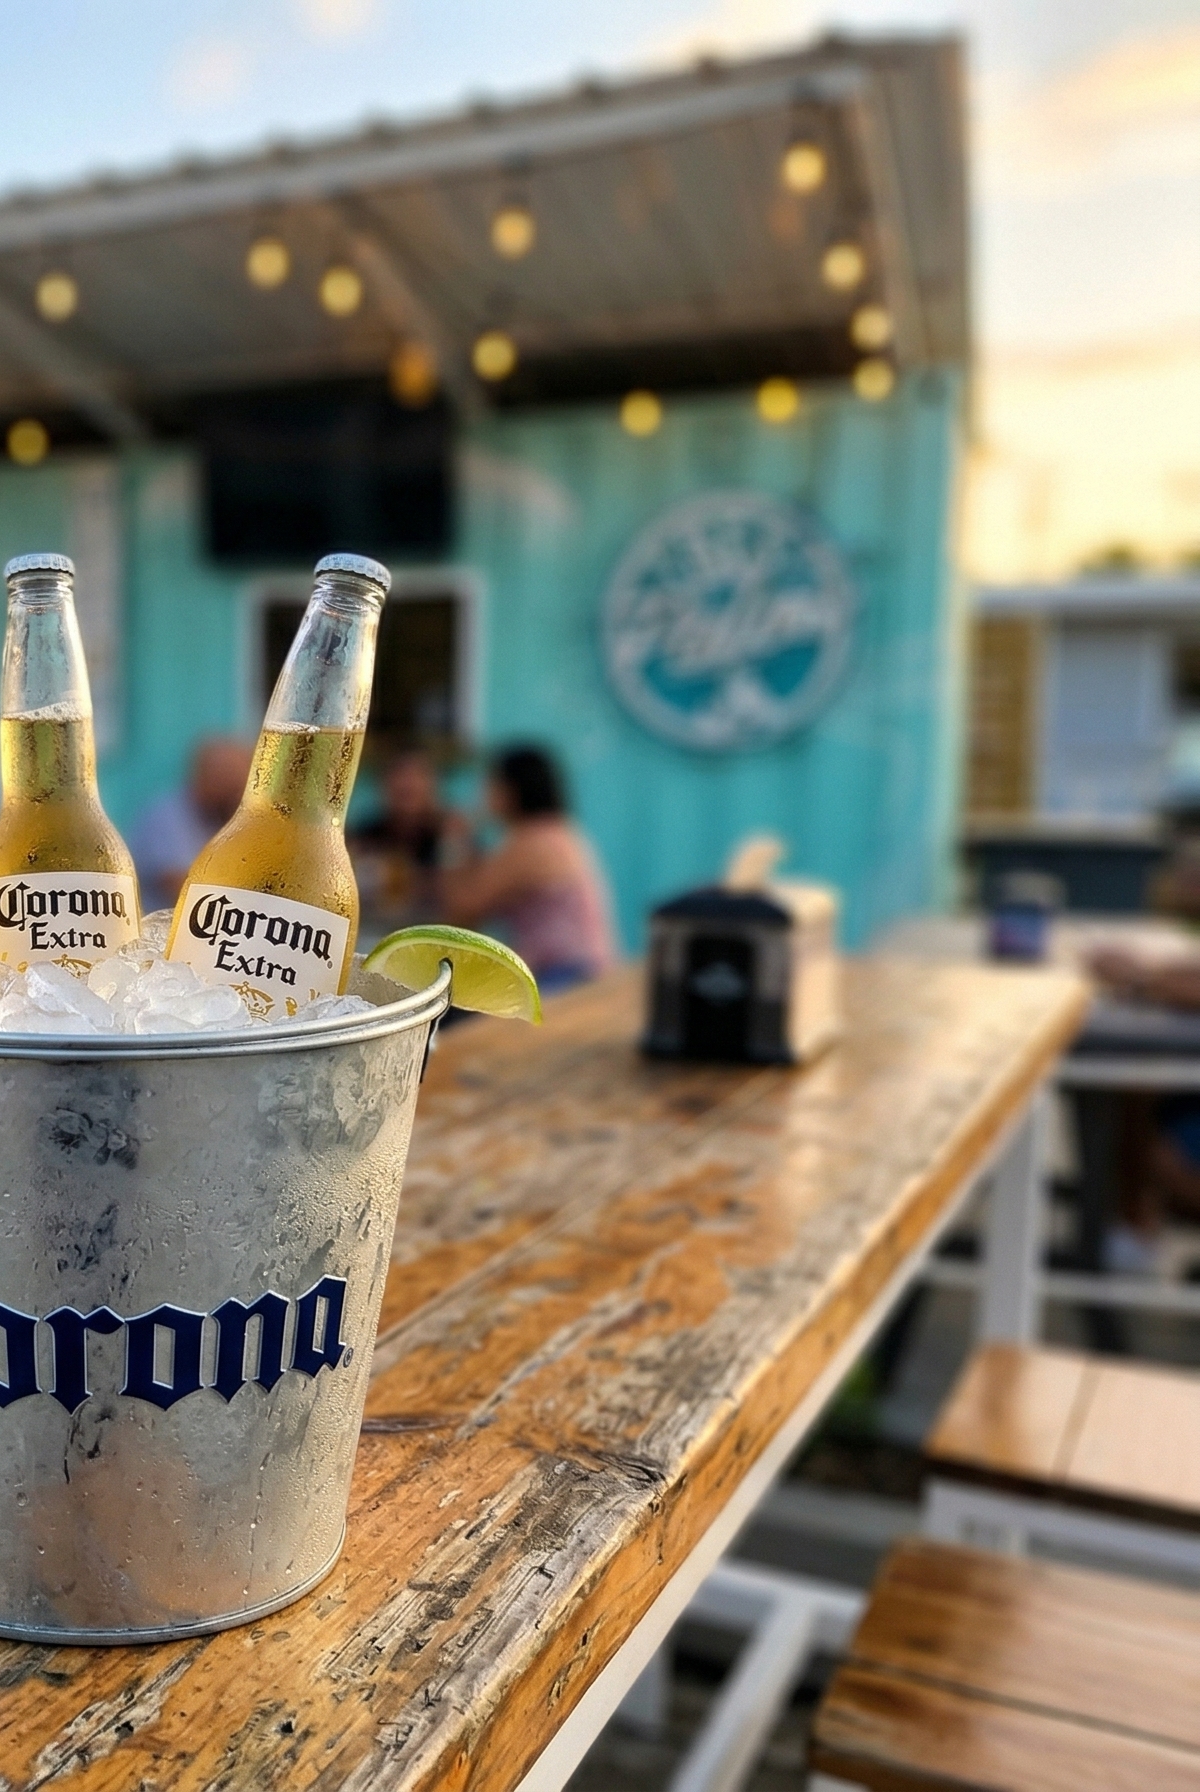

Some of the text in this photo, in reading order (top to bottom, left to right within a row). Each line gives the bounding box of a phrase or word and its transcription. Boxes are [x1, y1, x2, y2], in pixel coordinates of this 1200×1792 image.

[29, 922, 107, 950] Extra
[188, 893, 331, 961] Corona
[214, 940, 297, 986] Extra
